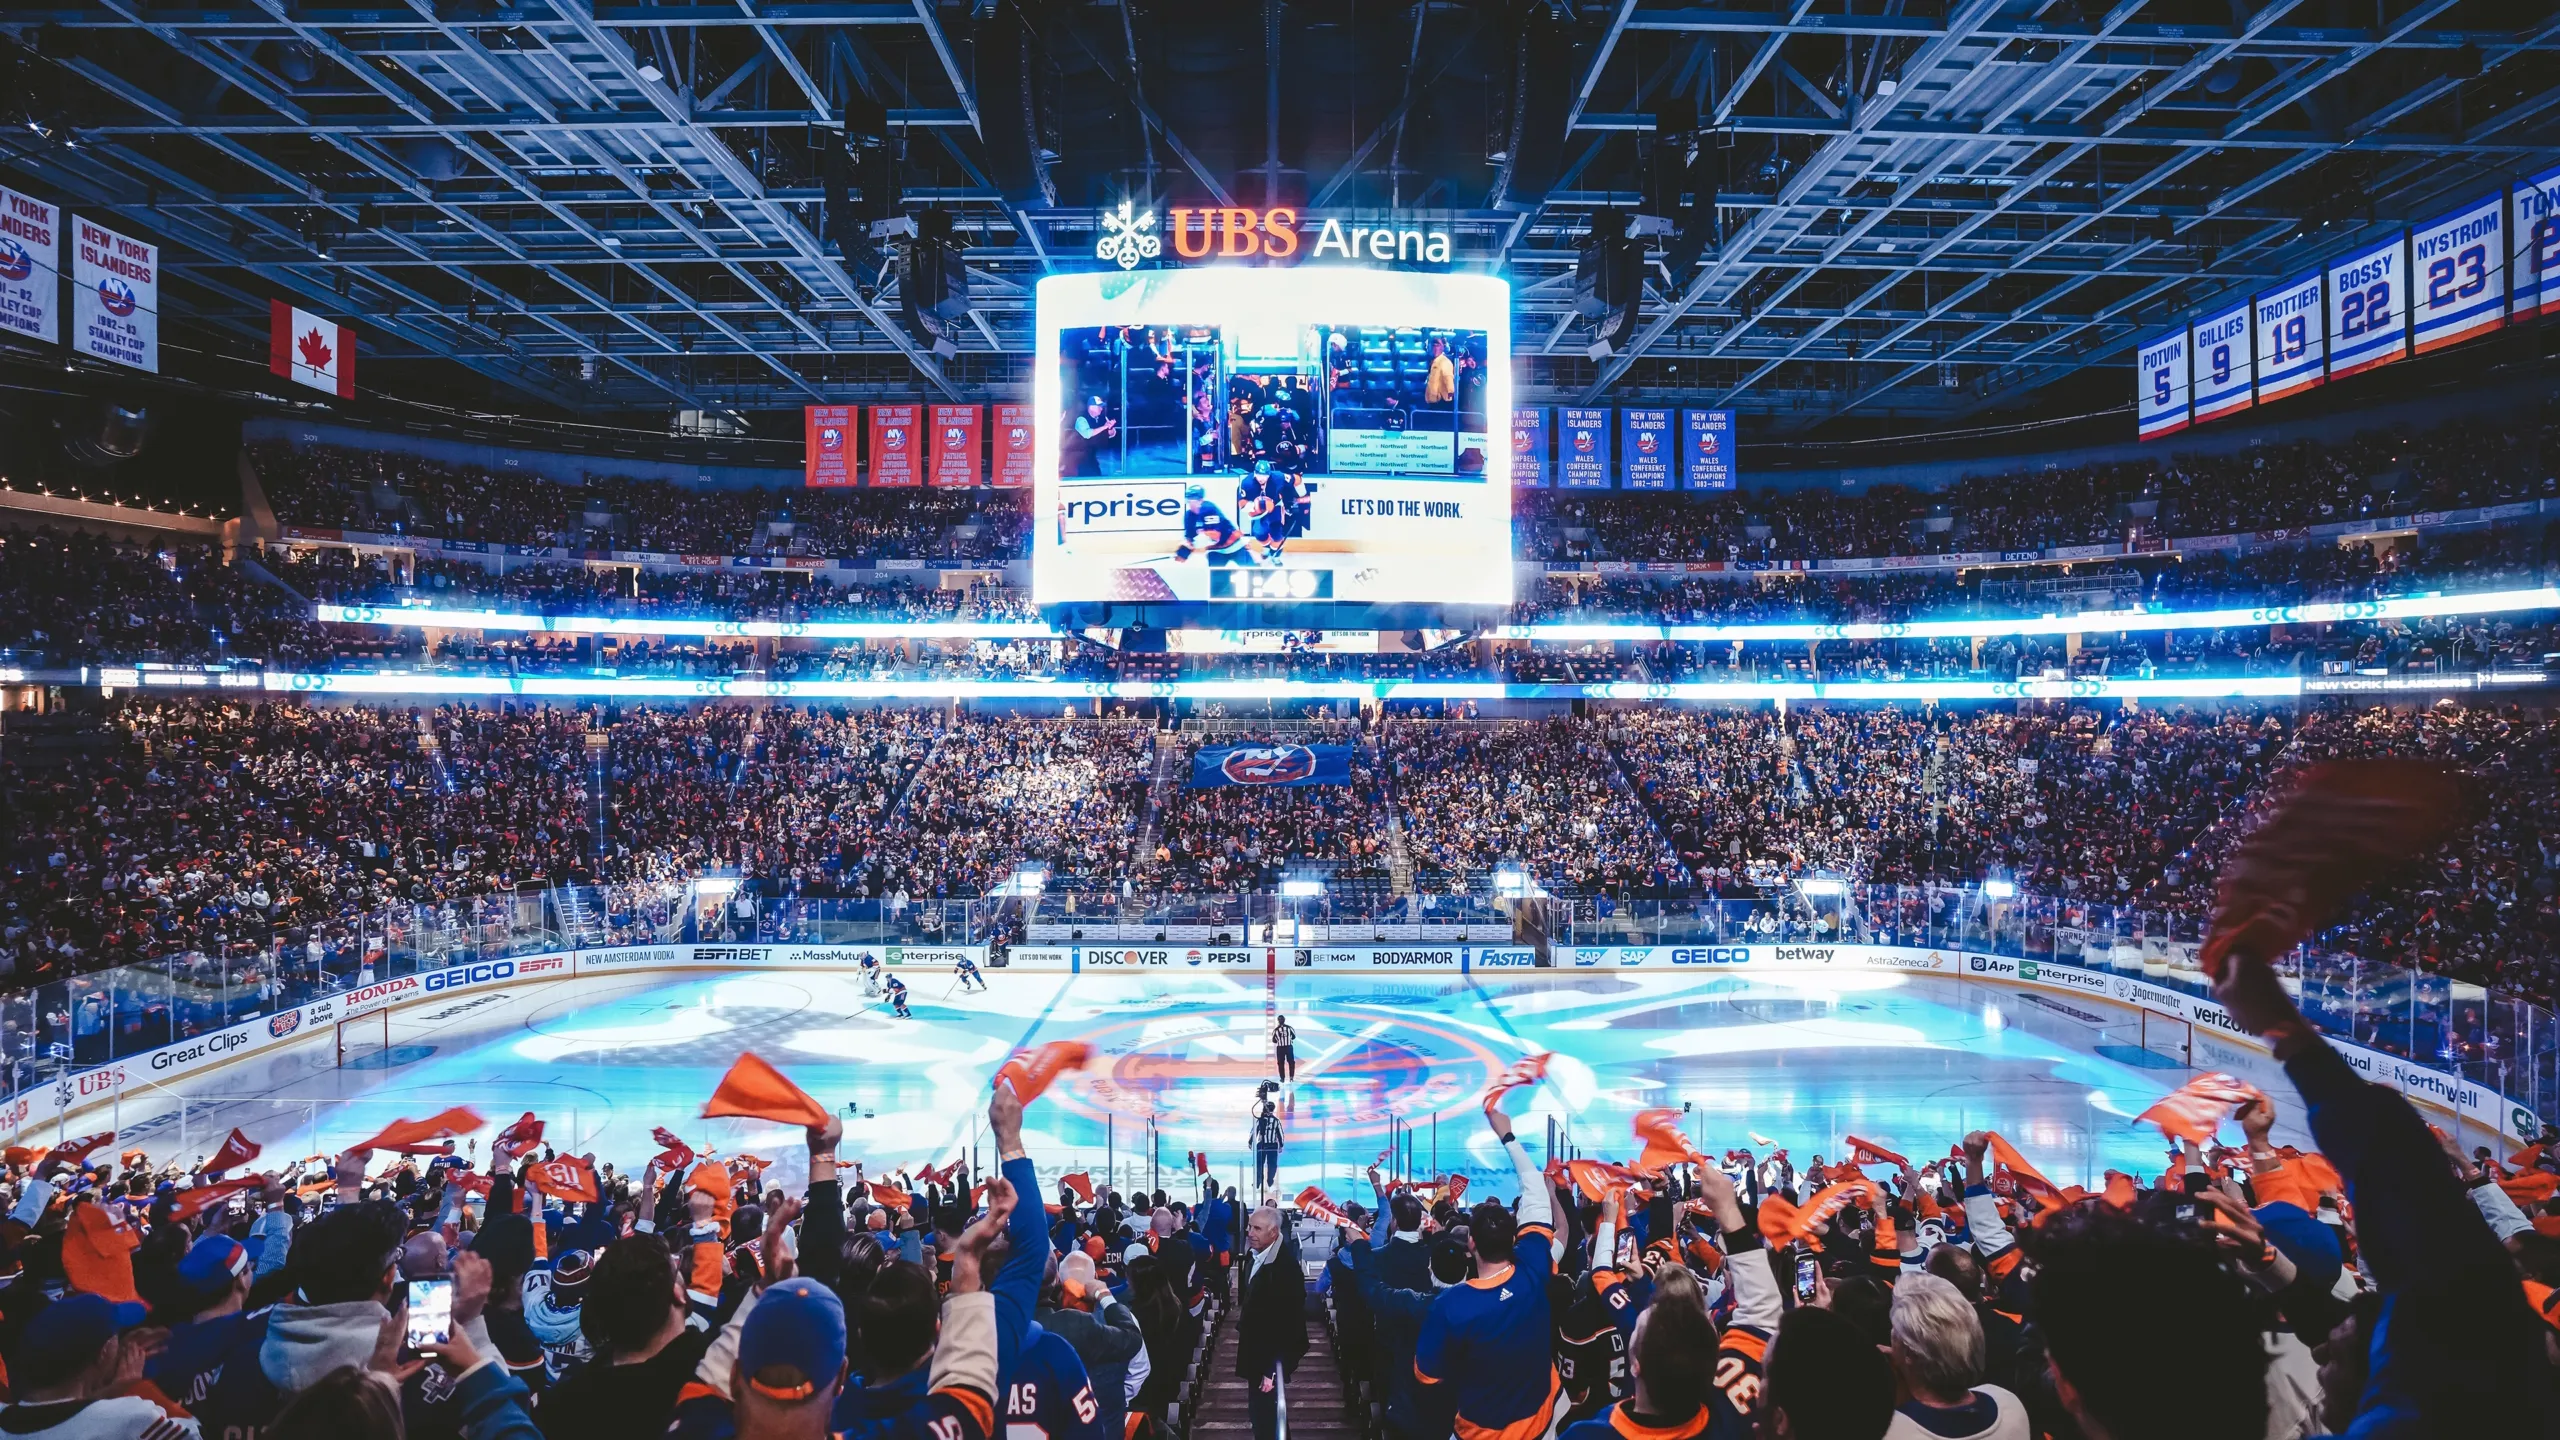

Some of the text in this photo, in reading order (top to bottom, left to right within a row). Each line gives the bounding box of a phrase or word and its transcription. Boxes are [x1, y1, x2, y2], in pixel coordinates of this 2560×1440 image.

[9, 194, 49, 225] YORK
[0, 214, 51, 247] NDERS
[1169, 208, 1451, 263] UBS Arena
[2417, 210, 2499, 261] NYSTROM
[81, 223, 149, 263] NEW YORK
[80, 243, 151, 284] ISLANDERS
[2339, 252, 2394, 294] BOSSY
[2428, 244, 2486, 310] 23
[22, 304, 42, 319] CUP
[2258, 285, 2319, 325] TROTTIER
[2341, 281, 2391, 341] 22
[88, 325, 145, 351] STANLEY CUP
[2199, 315, 2244, 349] GILLIES
[2272, 314, 2306, 366] 19
[91, 340, 143, 365] CHAMPIONS
[2143, 341, 2182, 371] POTVIN
[2212, 344, 2230, 386] 9
[2154, 365, 2171, 406] 5
[1567, 411, 1602, 419] NEW YORK
[1630, 412, 1665, 420] NEW YORK
[1692, 413, 1726, 421] NEW YORK
[1567, 420, 1602, 428] ISLANDERS
[1630, 421, 1665, 429] ISLANDERS
[1692, 422, 1726, 430] ISLANDERS
[1631, 472, 1664, 480] CHAMPIONS
[1067, 491, 1181, 526] rprise
[1341, 498, 1463, 518] LET'S DO THE WORK.
[795, 560, 826, 568] ISLANDERS
[2005, 551, 2038, 561] DEFEND
[1229, 569, 1318, 598] 1:49
[2305, 681, 2341, 690] NEW
[2342, 680, 2382, 689] YORK
[585, 950, 675, 965] NEW AMSTERDAM VODKA
[802, 950, 869, 961] MassMutu
[887, 949, 964, 964] enterprise
[1088, 950, 1168, 965] DISCOVER
[1208, 953, 1251, 963] PEPSI
[1313, 953, 1356, 962] BETMGM
[1372, 951, 1453, 965] BODYARMOR
[1576, 952, 1600, 963] SAP
[1621, 952, 1646, 963] SAP
[1672, 948, 1750, 964] GEICO
[1775, 946, 1835, 963] betway
[1866, 955, 1929, 968] AstraZeneca
[518, 957, 564, 973] ESPN
[425, 961, 514, 992] GEICO
[2019, 965, 2105, 988] enterprise
[345, 975, 419, 1006] HONDA
[318, 1002, 331, 1013] sub
[360, 1001, 381, 1011] Power
[273, 1012, 297, 1027] Jersey
[309, 1011, 333, 1026] above
[2193, 1005, 2253, 1037] verizo
[151, 1031, 248, 1071] Great Clips
[78, 1066, 125, 1097] UBS
[2394, 1065, 2478, 1109] Northwell
[1036, 1166, 1198, 1176] MERICAN
[1006, 1383, 1036, 1415] AS
